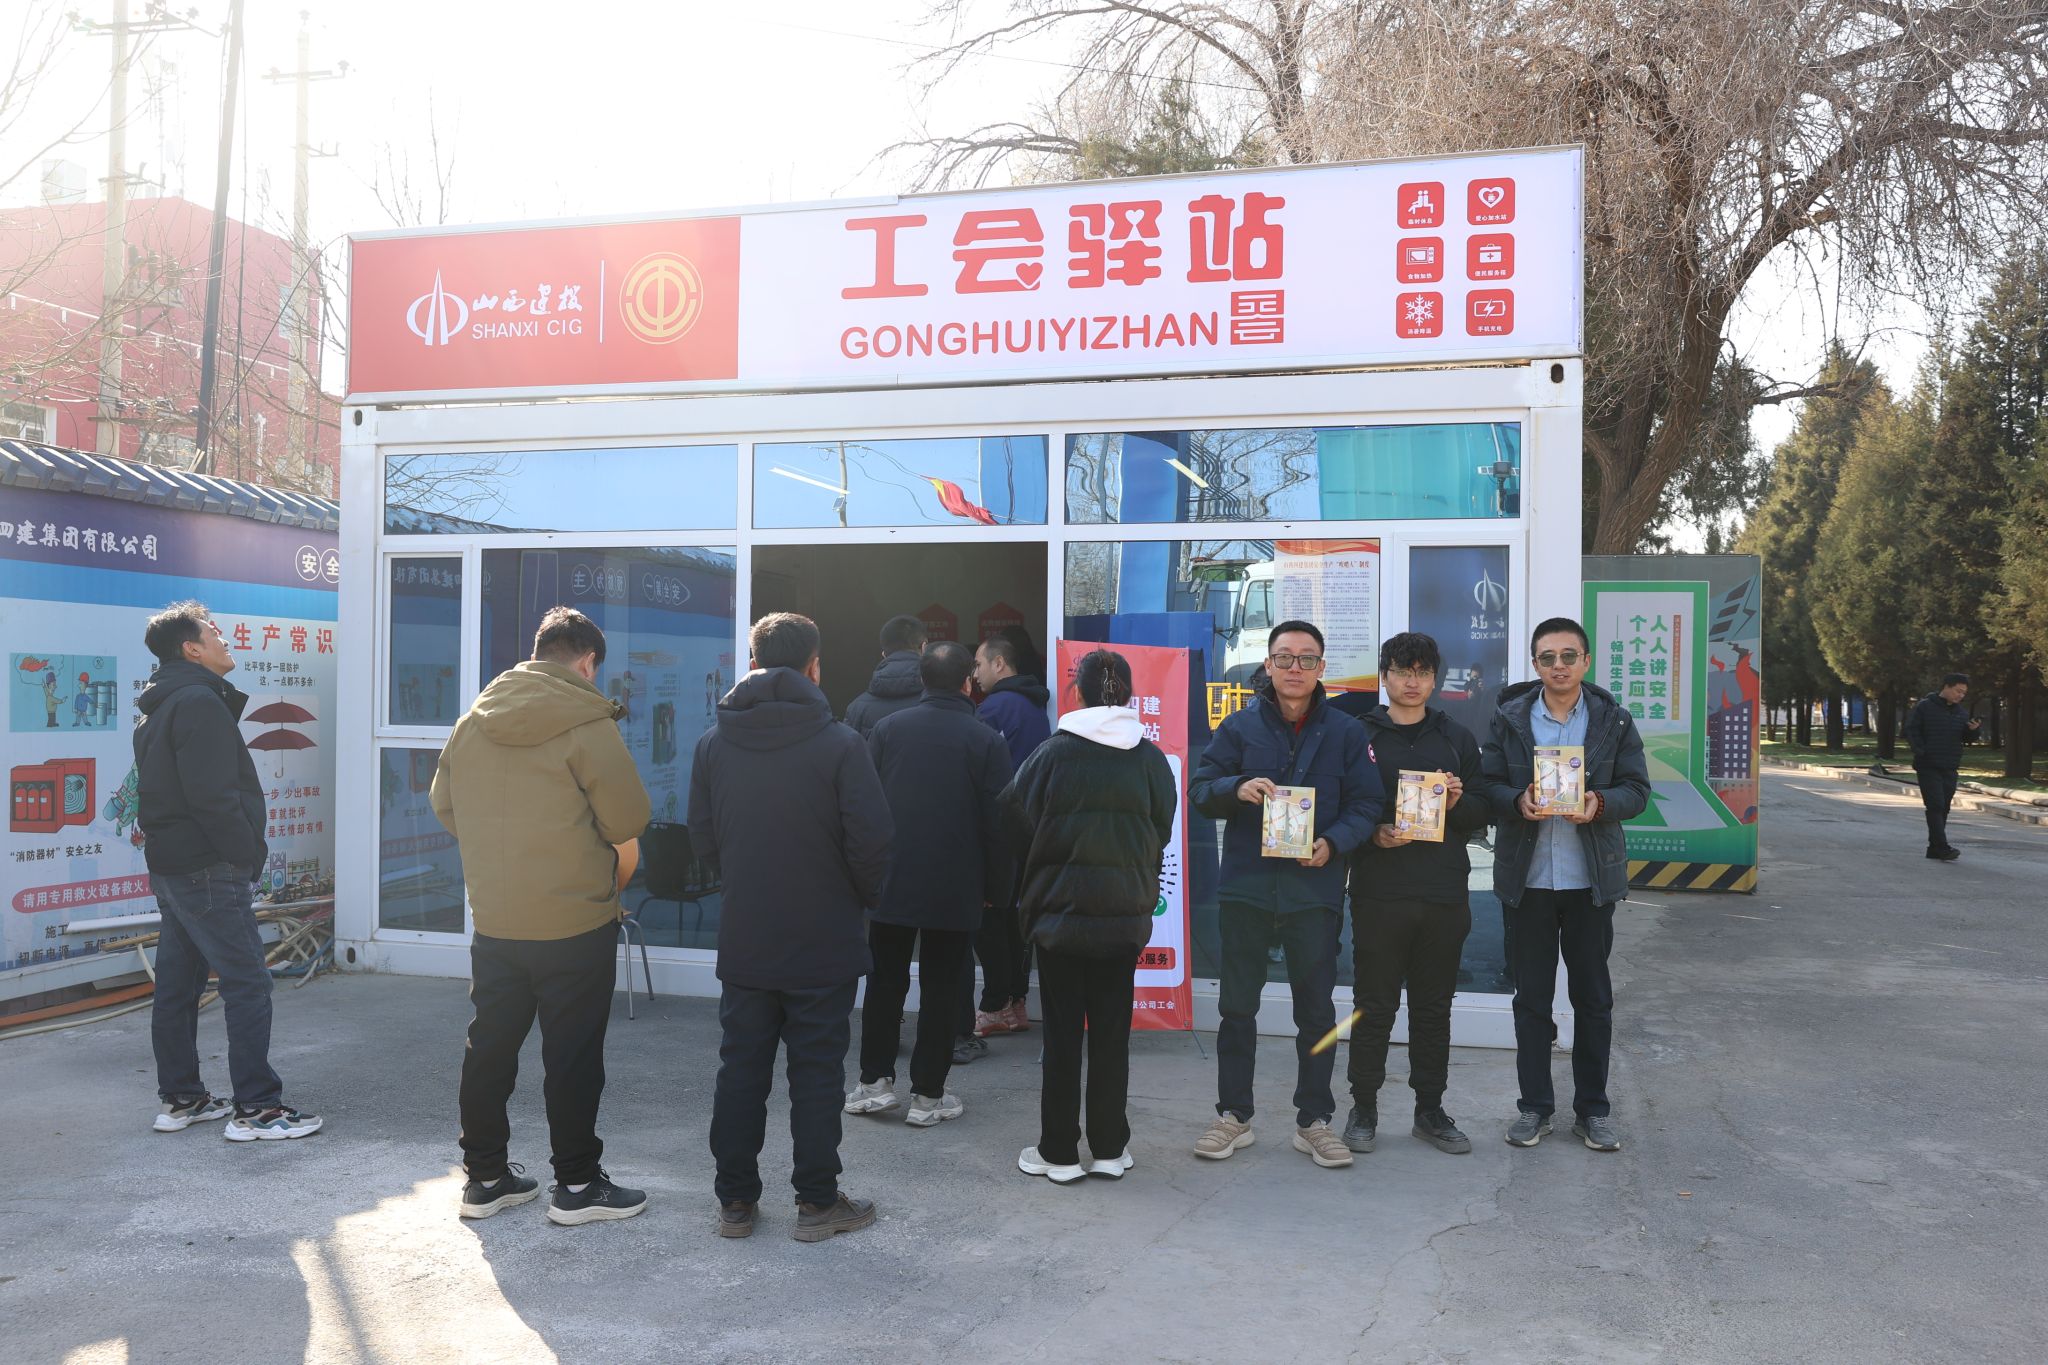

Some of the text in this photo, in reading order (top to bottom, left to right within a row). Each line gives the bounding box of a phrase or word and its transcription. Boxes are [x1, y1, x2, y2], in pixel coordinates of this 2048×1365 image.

[841, 192, 1286, 299] 工会驿站
[472, 283, 583, 316] 山西建投
[471, 318, 583, 340] SHANXI CIG
[840, 311, 1219, 360] GONGHUIYIZHAN
[0, 519, 158, 561] 四建集团有限公司
[209, 621, 334, 654] 生产常识
[244, 661, 299, 673] 比平常多一层防护
[1628, 614, 1647, 719] 个个会应急
[1649, 614, 1668, 719] 人人讲安全
[285, 786, 321, 799] 少出事故
[65, 843, 103, 858] 安全之友
